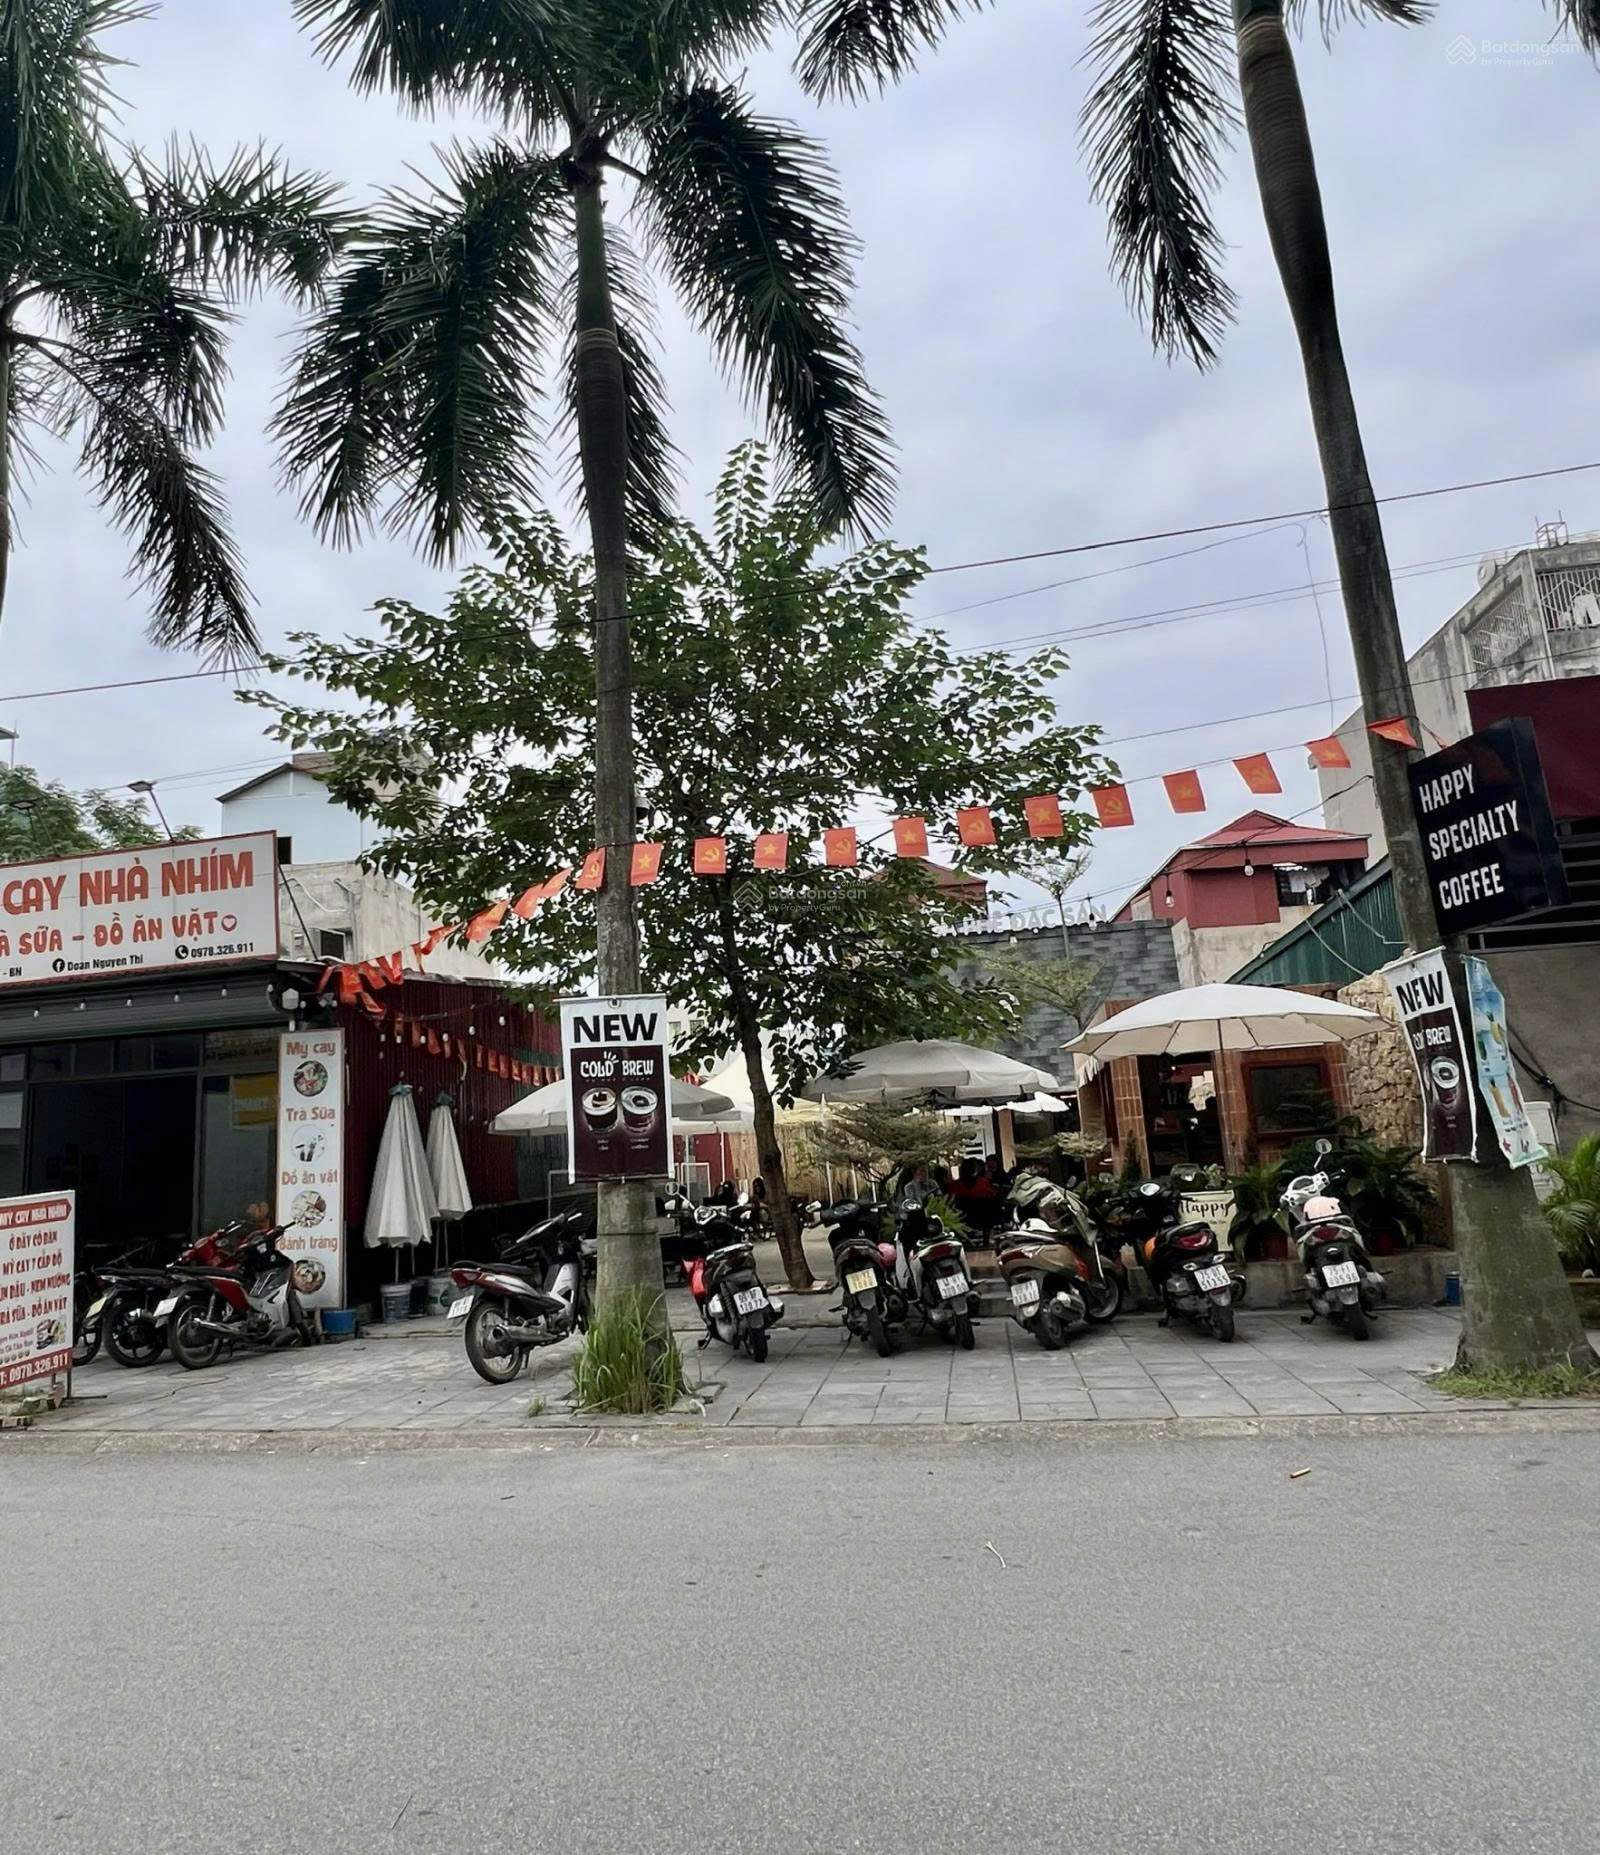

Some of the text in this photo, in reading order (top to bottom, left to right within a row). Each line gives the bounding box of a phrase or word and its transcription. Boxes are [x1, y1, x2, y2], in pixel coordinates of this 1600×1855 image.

[1419, 764, 1475, 814] HAPPY
[1428, 800, 1520, 861] SPECIALTY
[3, 848, 254, 915] CAY NHÀ NHÍM
[1438, 863, 1505, 910] COFFEE
[18, 924, 63, 955] SỮA
[94, 912, 124, 947] ĐỒ
[133, 914, 163, 943] ĂN
[172, 908, 218, 942] VẶT
[191, 942, 254, 959] 0978.326.911
[93, 956, 127, 970] Nguyen
[573, 1013, 658, 1043] NEW
[313, 1042, 336, 1057] cay
[580, 1059, 654, 1078] COLD BREW
